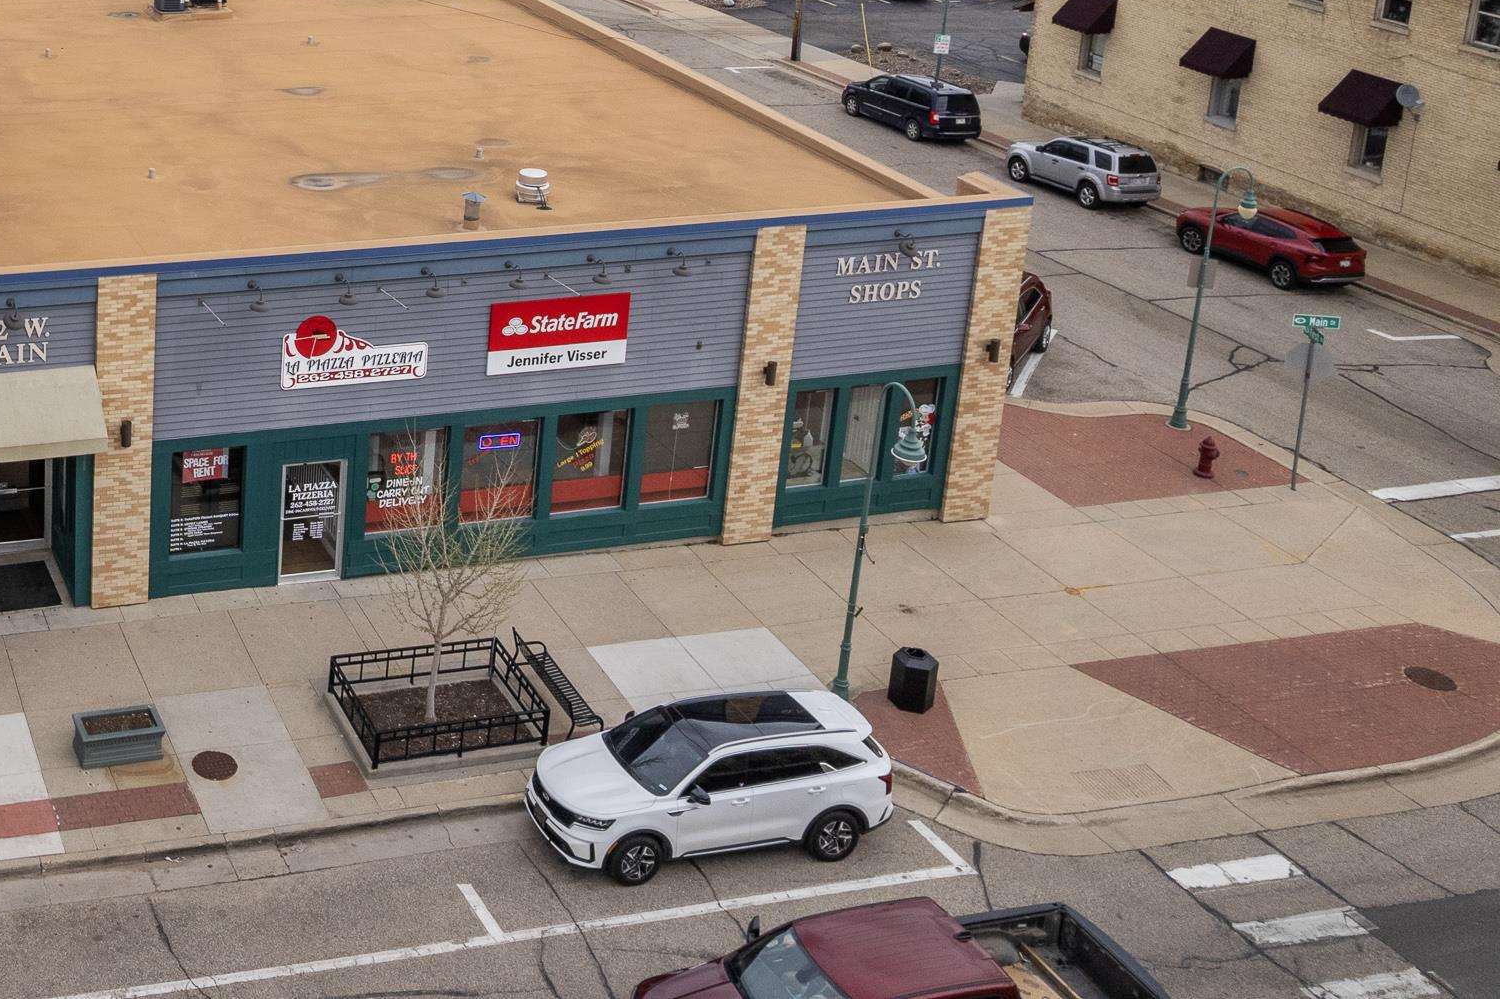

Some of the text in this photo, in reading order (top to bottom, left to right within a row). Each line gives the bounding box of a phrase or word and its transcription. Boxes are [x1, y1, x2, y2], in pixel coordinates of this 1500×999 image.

[836, 249, 941, 276] MAIN ST.
[848, 280, 921, 304] SHOPS
[25, 317, 50, 338] W.
[1310, 317, 1328, 327] Main
[285, 350, 424, 375] LA PIAZZA PIZZERIA
[507, 349, 608, 368] Jennifer Visser
[482, 436, 518, 447] OEN
[183, 454, 229, 469] SPACE FOR
[193, 466, 216, 478] RENT
[288, 480, 338, 493] LA PIAZZA
[376, 487, 408, 499] CARRY
[292, 490, 334, 501] PIZZERIA
